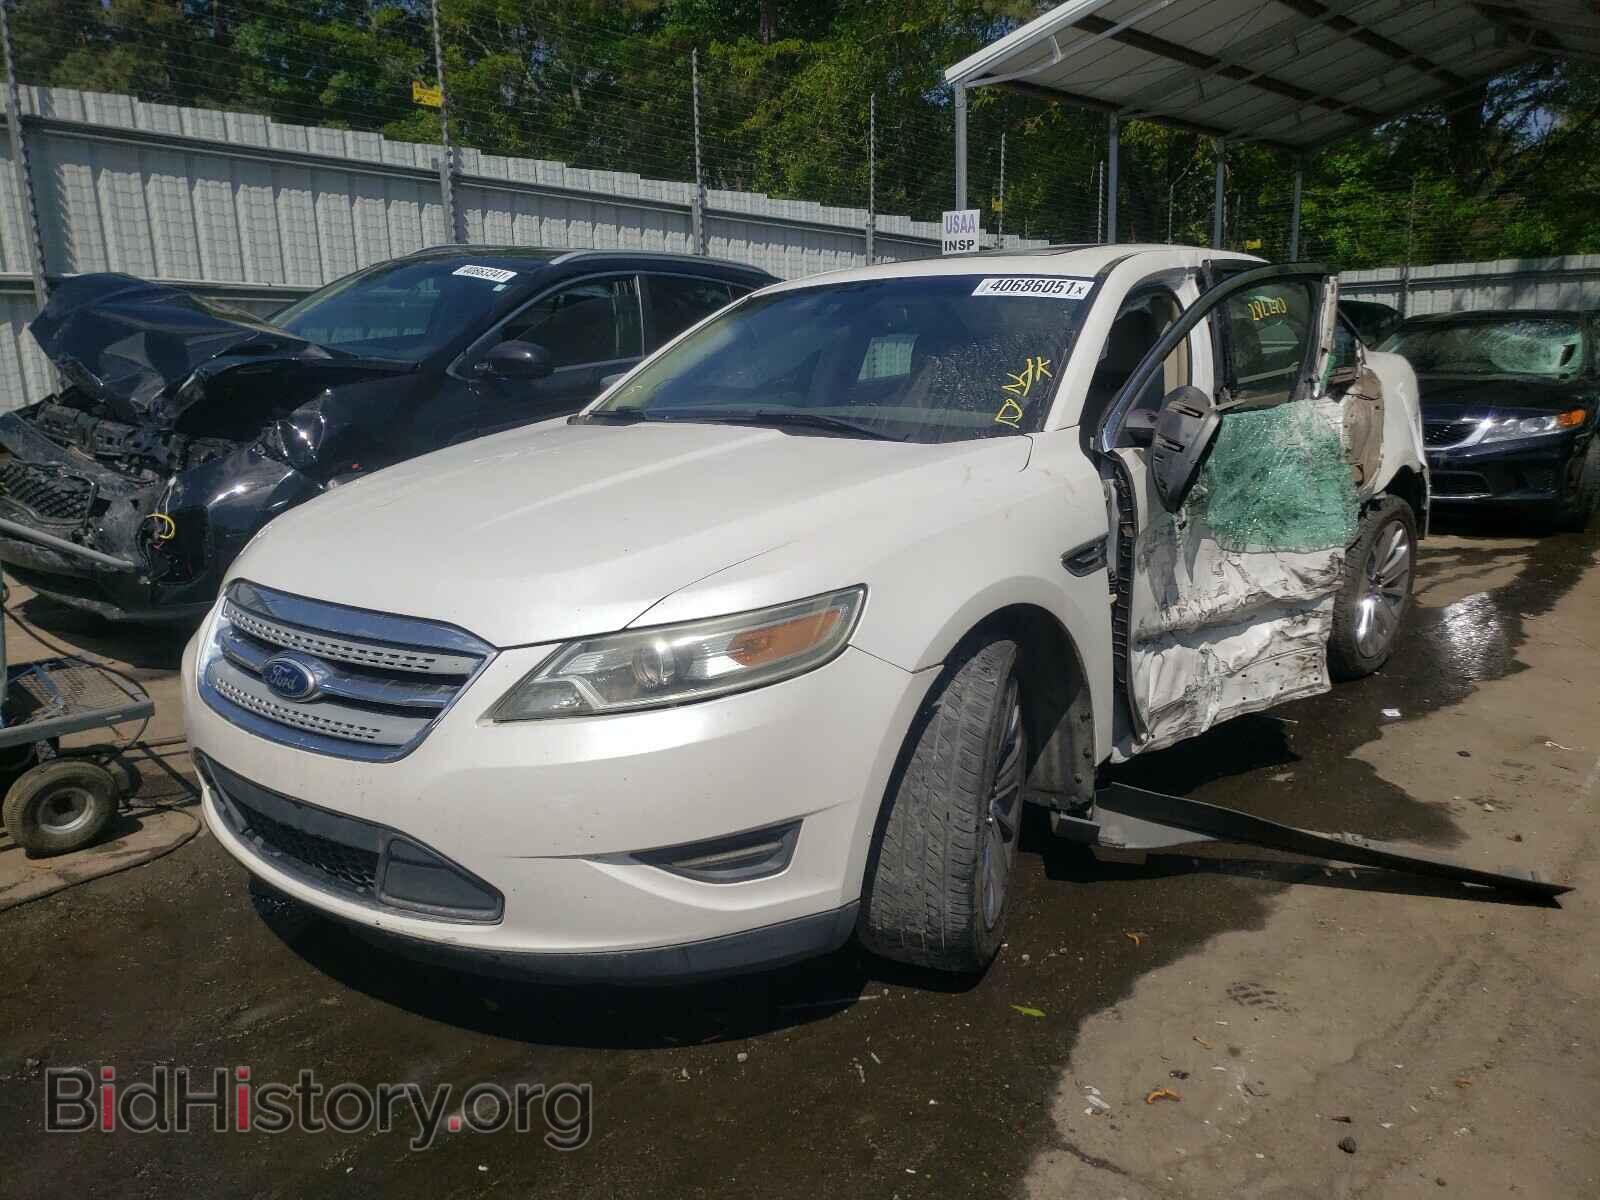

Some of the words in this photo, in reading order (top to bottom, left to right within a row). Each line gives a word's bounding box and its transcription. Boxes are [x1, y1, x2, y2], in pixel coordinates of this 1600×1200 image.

[945, 213, 976, 233] USAA
[944, 239, 975, 251] INSP
[272, 664, 298, 689] Ford
